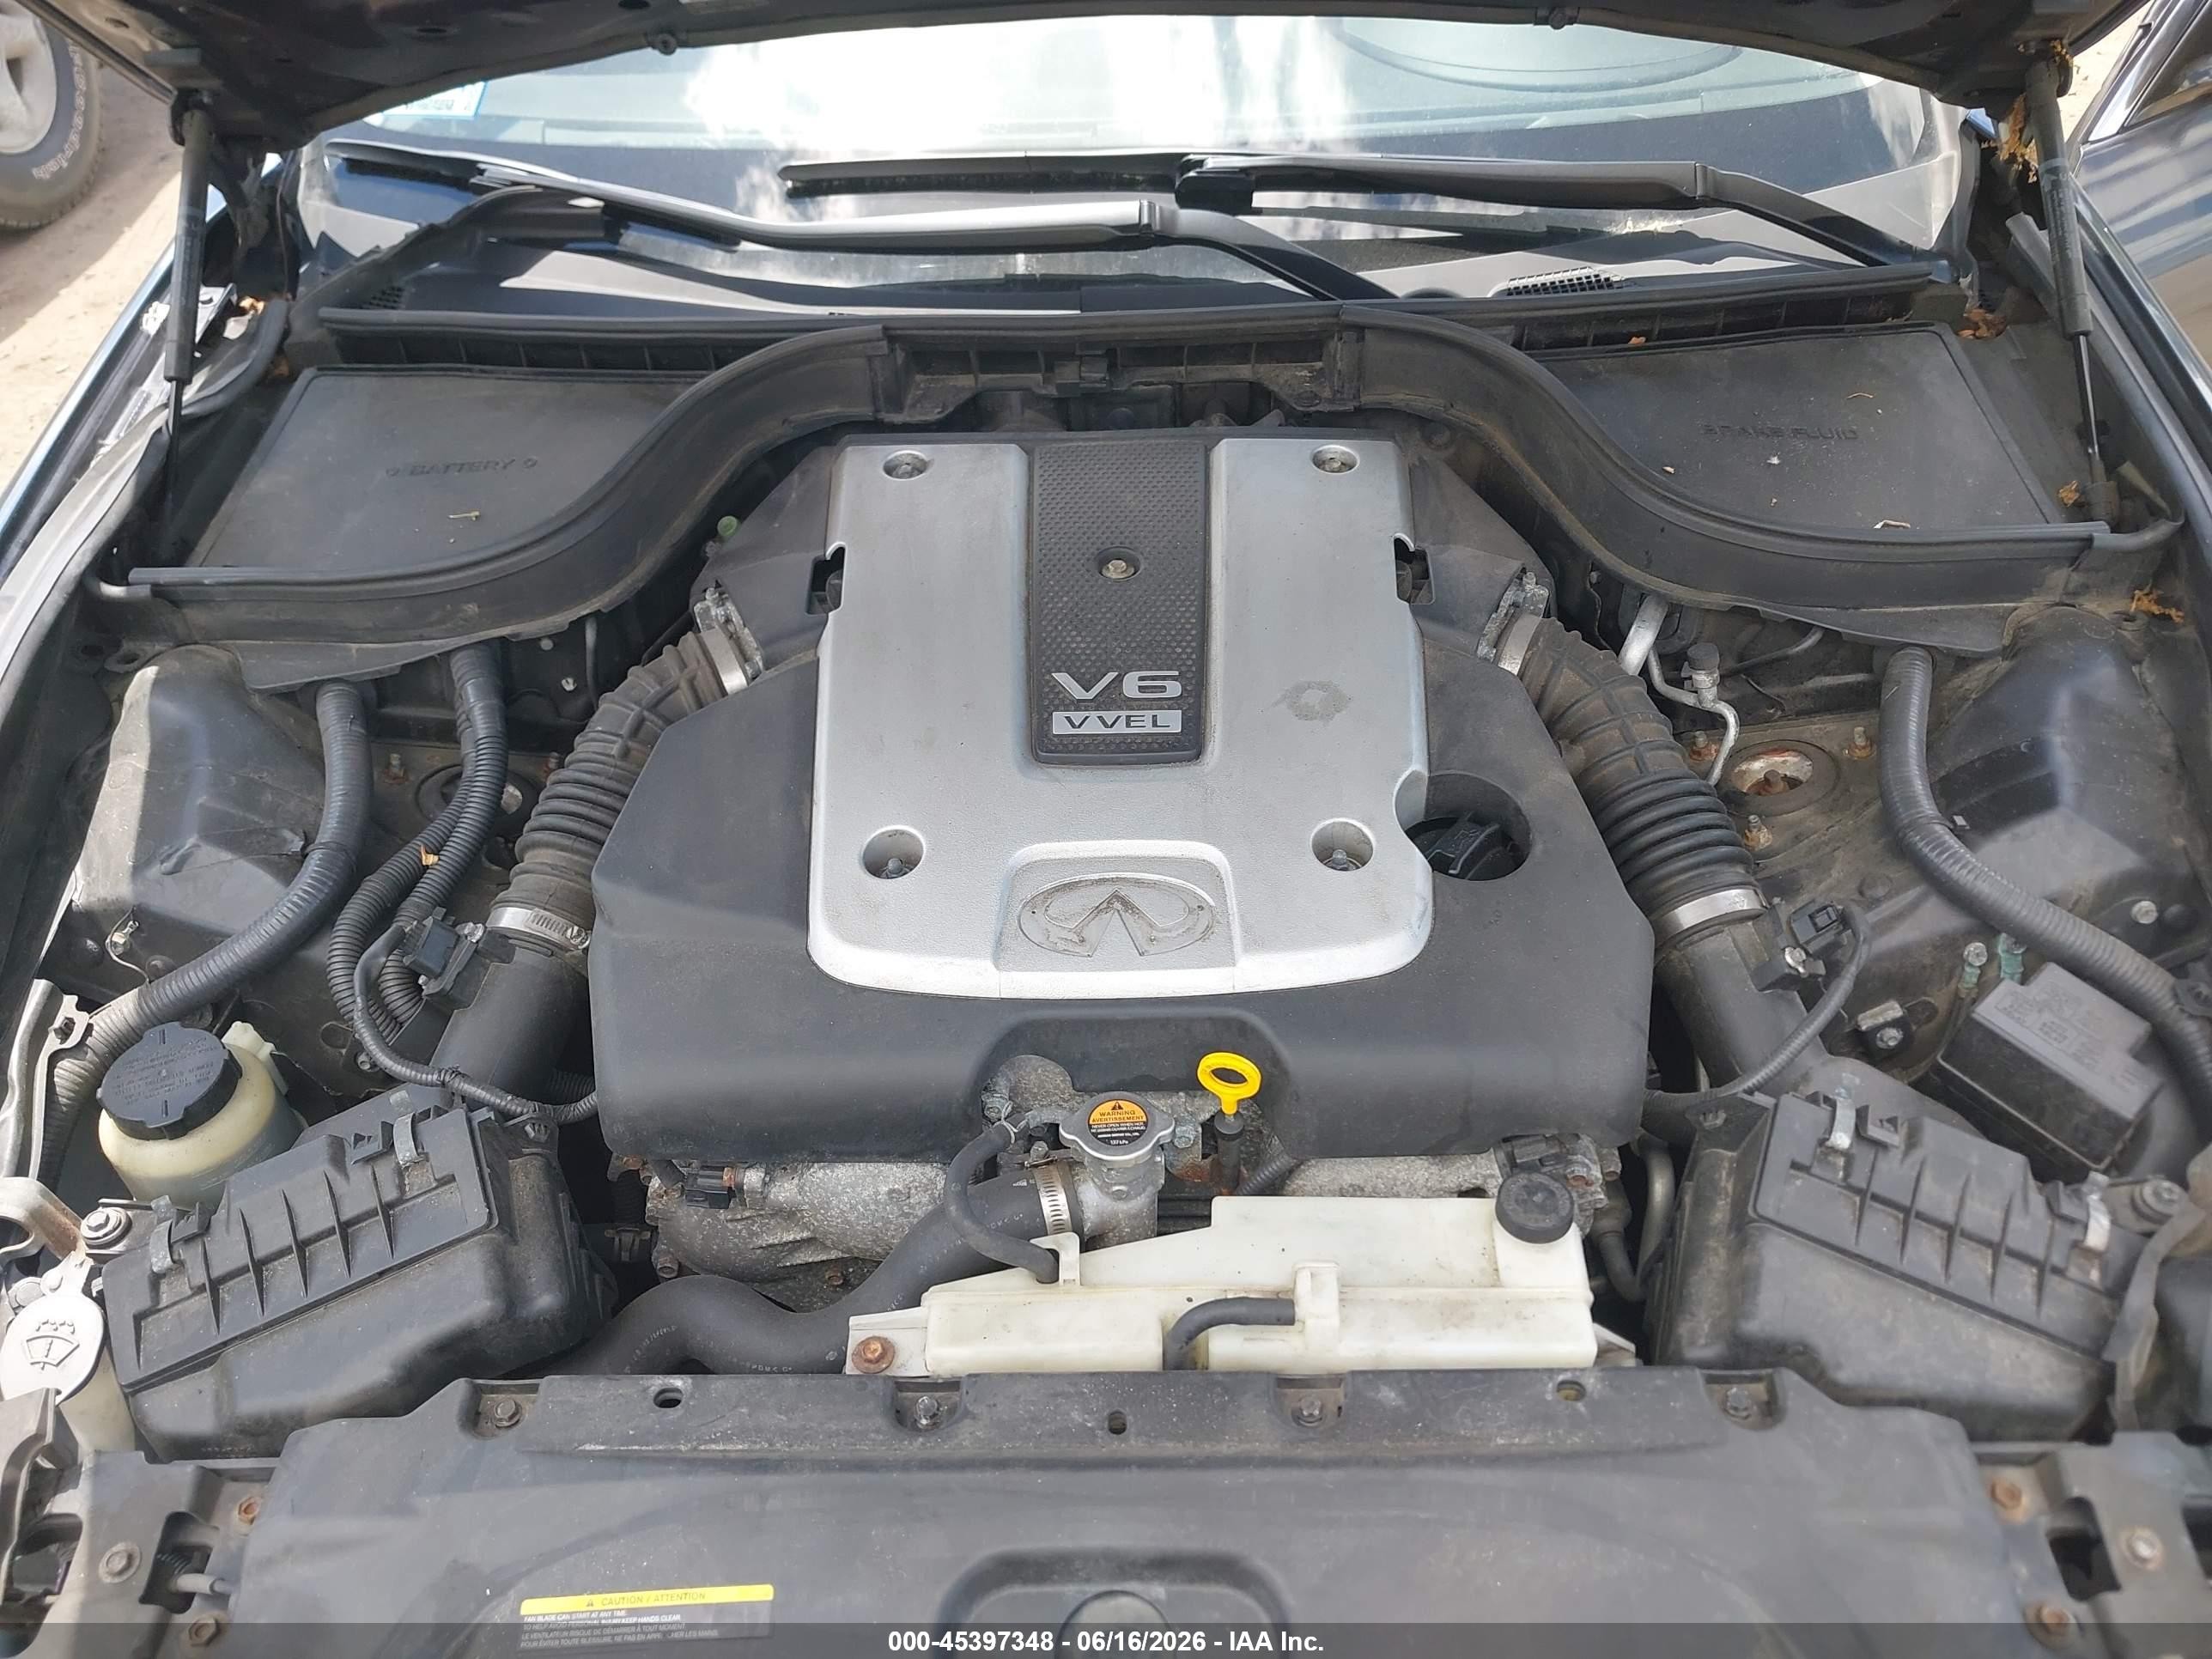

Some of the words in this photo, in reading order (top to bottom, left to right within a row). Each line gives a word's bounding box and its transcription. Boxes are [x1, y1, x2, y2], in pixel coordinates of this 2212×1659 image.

[1051, 671, 1182, 700] V6
[1065, 714, 1171, 729] VVEL
[601, 1596, 643, 1606] CAUTION
[653, 1592, 705, 1602] ATTENTION
